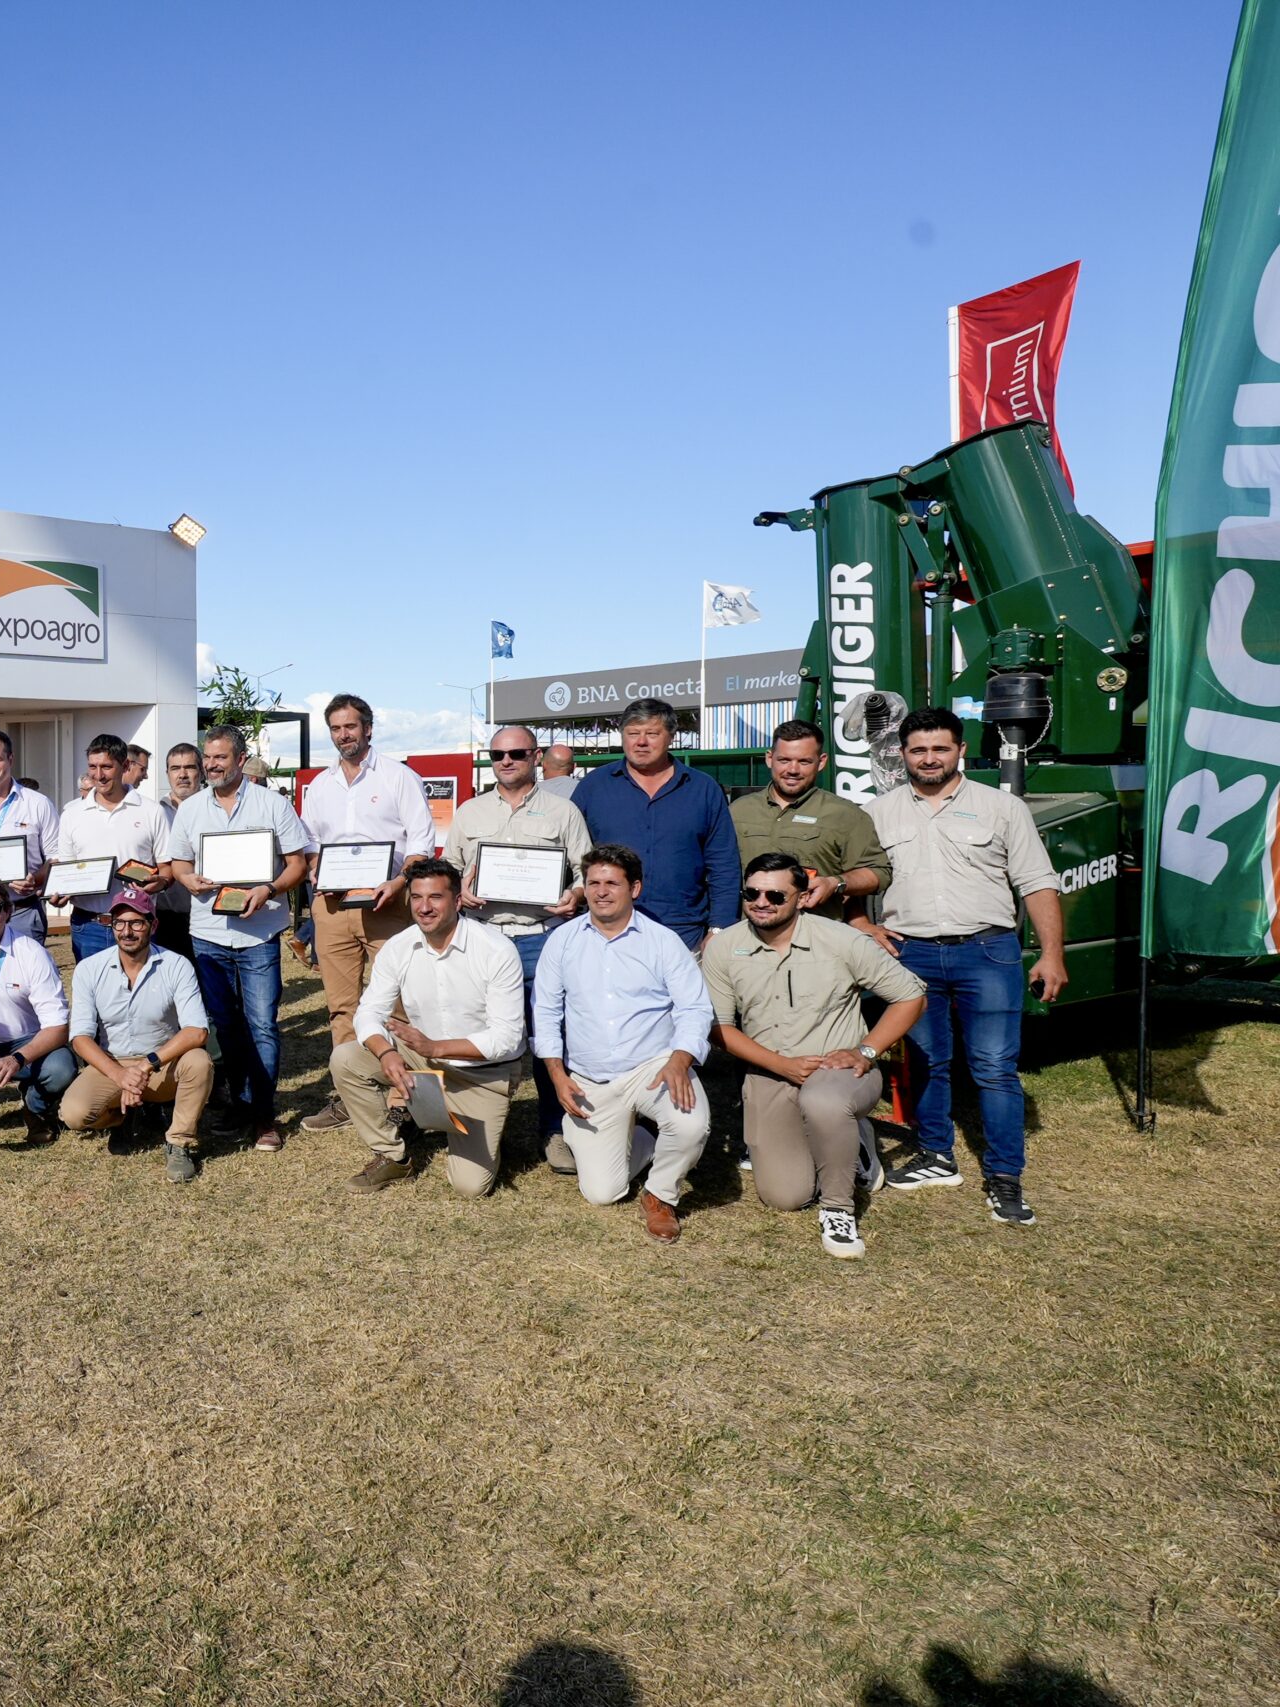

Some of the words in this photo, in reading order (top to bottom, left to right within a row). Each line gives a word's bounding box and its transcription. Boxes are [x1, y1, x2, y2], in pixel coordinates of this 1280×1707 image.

[1160, 243, 1280, 885] RICH
[577, 684, 620, 704] BNA
[625, 677, 704, 700] Conecta
[726, 676, 740, 692] El
[1058, 854, 1118, 896] CHIGER
